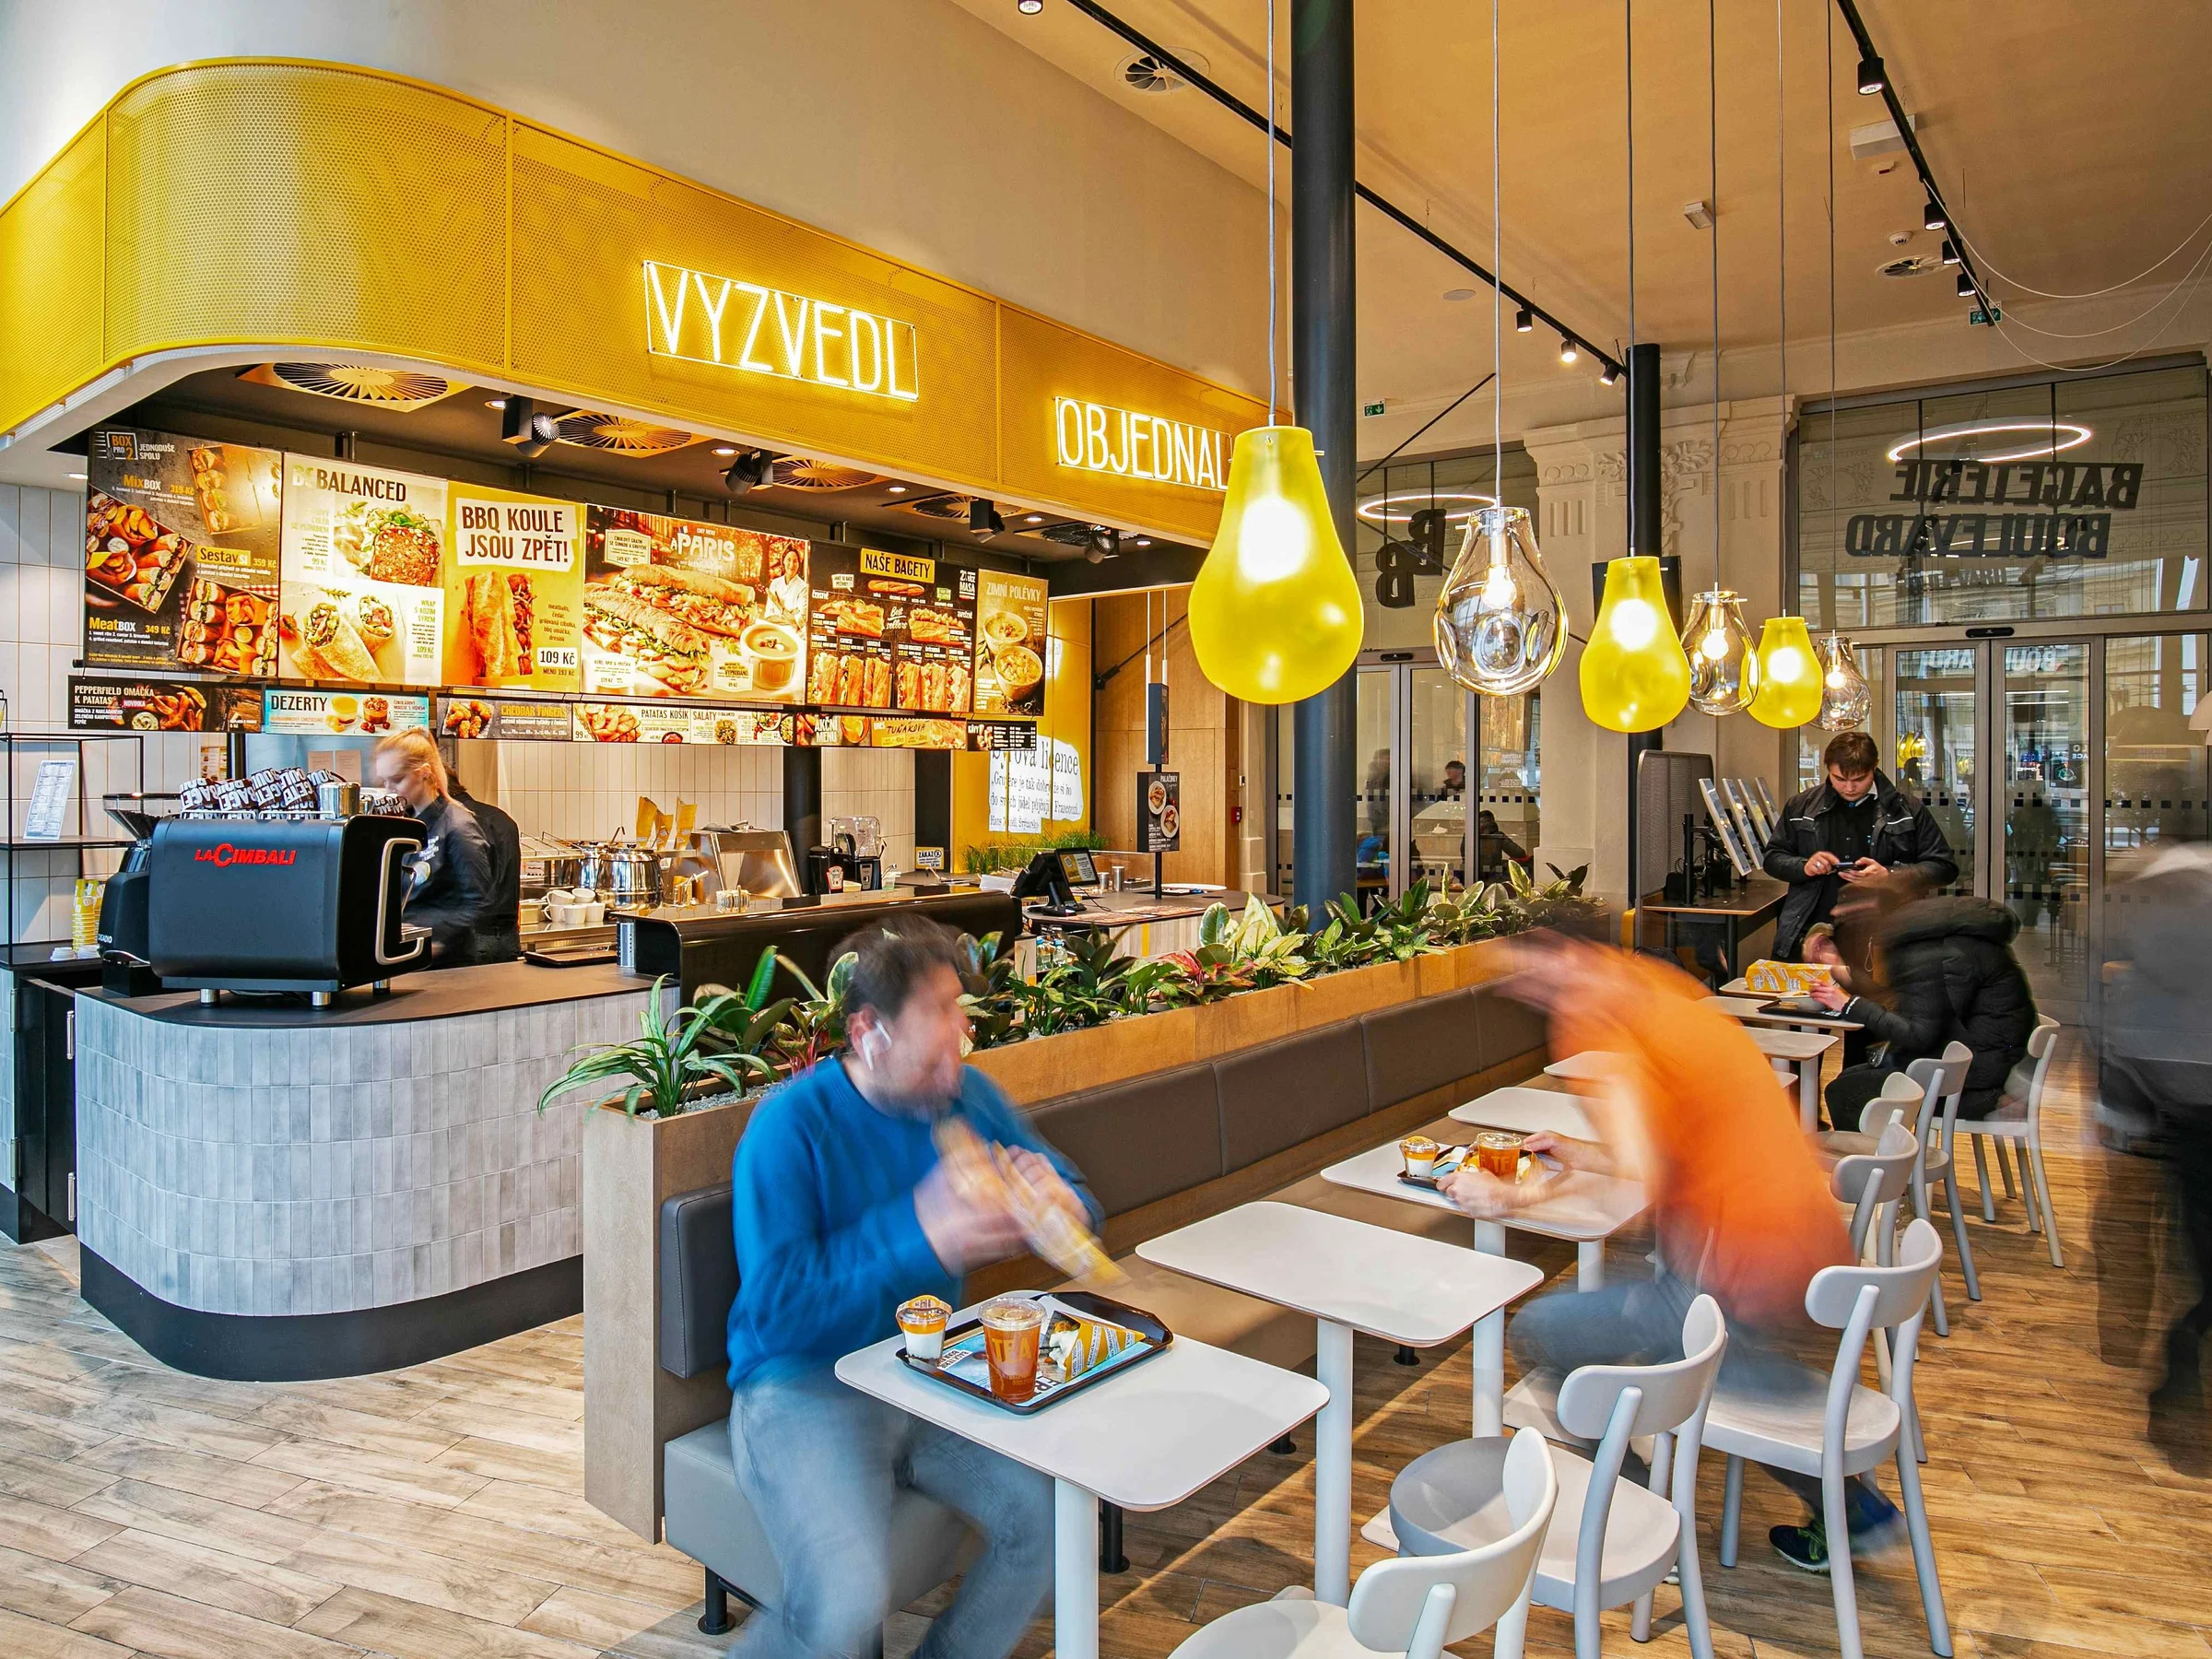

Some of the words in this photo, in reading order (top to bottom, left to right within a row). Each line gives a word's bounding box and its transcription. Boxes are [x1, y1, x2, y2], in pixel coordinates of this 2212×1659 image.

[649, 262, 918, 399] VYZVEDL
[112, 435, 132, 446] BOX
[139, 443, 175, 453] JEDNODUŠE
[1059, 399, 1229, 489] OBJEDNAL
[125, 448, 134, 461] 2
[316, 468, 406, 502] BALANCED
[462, 506, 500, 534] BBQ
[507, 508, 564, 533] KOULE
[465, 534, 513, 559] JSOU
[522, 535, 568, 563] ZPĚT!
[677, 533, 735, 561] PARIS
[865, 553, 890, 572] NAŠE
[894, 559, 930, 578] BAGETY
[986, 582, 1007, 597] ZIMNÍ
[1010, 584, 1041, 602] POLÉVKY
[88, 617, 135, 632] MeatBOX
[145, 625, 159, 633] 349
[540, 650, 559, 664] 109
[563, 652, 575, 665] Kč
[75, 686, 121, 695] PEPPERFIELD
[75, 695, 80, 703] K
[83, 696, 112, 704] PATATAS
[271, 695, 328, 712] DEZERTY
[501, 705, 535, 716] CHEDDAR
[536, 706, 567, 717] FINGERS
[641, 709, 667, 719] PATATAS
[669, 709, 688, 719] KOŠÍK
[815, 715, 838, 732] AKČNÍ
[992, 1337, 1032, 1362] TEA
